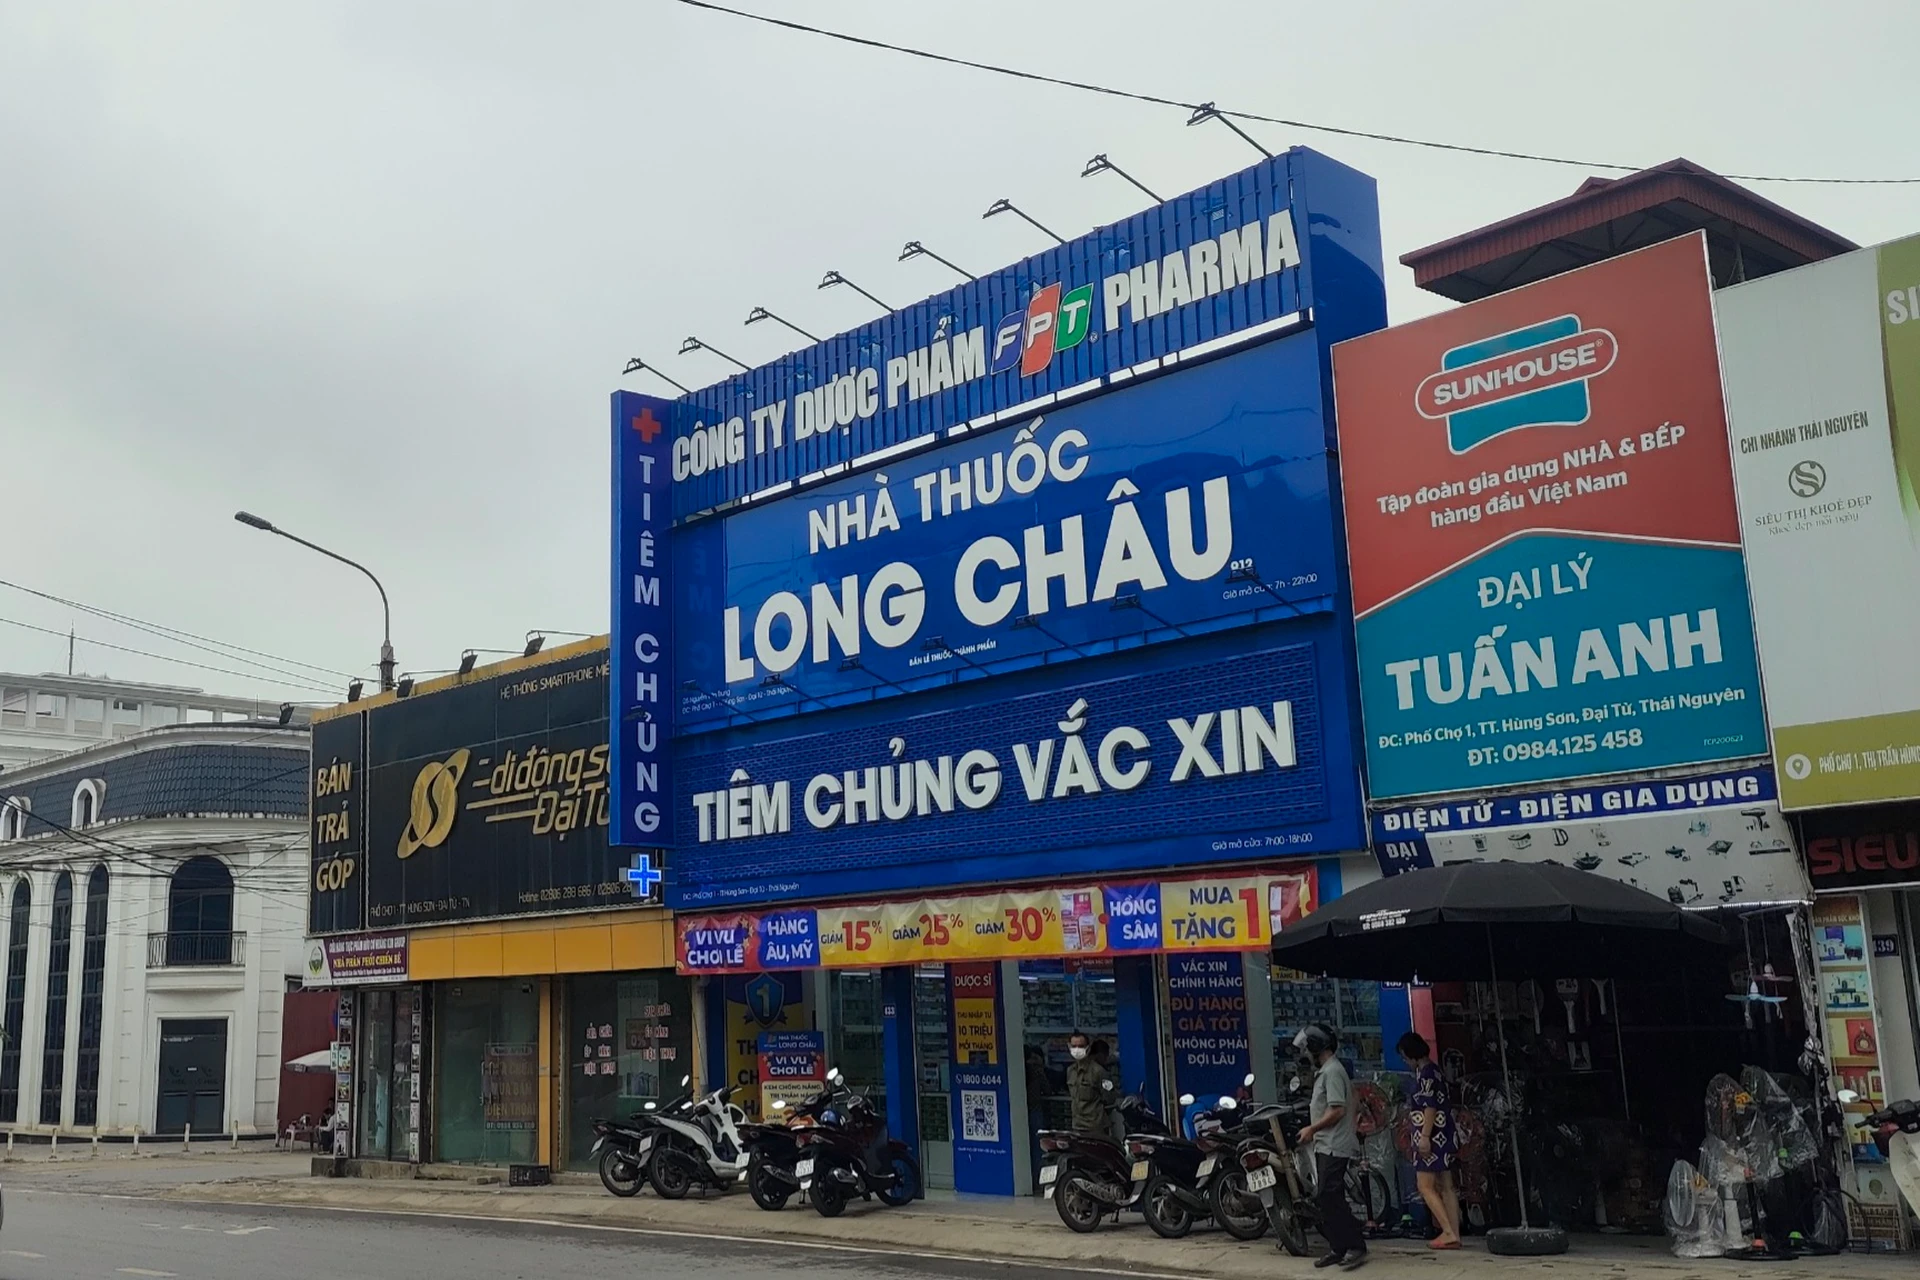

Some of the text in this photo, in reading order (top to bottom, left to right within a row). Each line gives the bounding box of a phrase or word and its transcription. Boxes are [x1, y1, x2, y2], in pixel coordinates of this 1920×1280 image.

[672, 208, 1301, 482] CÔNG TY DƯỢC PHẨM FPT PHARMA
[1434, 342, 1596, 406] SUNHOUSE
[1740, 410, 1868, 454] CHI NHÁNH THÁI NGUYÊN
[1378, 422, 1686, 515] Tập đoàn gia dụng NHÀ & BẾP
[809, 415, 1090, 554] NHÀ THUỐC
[1431, 471, 1628, 527] hàng đầu Việt Nam
[1755, 513, 1782, 526] SIÊU
[1785, 508, 1808, 521] THỊ
[724, 477, 1233, 683] LONG CHÂU
[1292, 573, 1317, 586] 22h00
[1478, 552, 1594, 610] ĐẠI LÝ
[634, 455, 660, 834] TIÊM CHỦNG
[1386, 608, 1723, 711] TUẤN ANH
[540, 668, 593, 690] SMARTPHONE
[1378, 686, 1745, 748] ĐC: Phố Chợ 1, TT. Hùng Sơn, Đại Từ, Thái Nguyên
[1468, 728, 1642, 766] ĐT: 0984.125 458
[1819, 752, 1834, 773] PHỐ
[1836, 754, 1851, 774] CHỢ
[1856, 753, 1862, 771] 1,
[1862, 752, 1876, 771] THỊ
[1878, 744, 1899, 767] TRẤN
[316, 757, 351, 797] BÁN
[693, 697, 1298, 842] TIÊM CHỦNG VẮC XIN
[1384, 776, 1759, 831] ĐIỆN TỬ ĐIỆN GIA DỤNG
[316, 800, 349, 844] TRẢ
[1212, 841, 1227, 850] Giờ
[1229, 839, 1242, 849] mở
[1385, 841, 1418, 860] ĐẠI
[316, 852, 354, 892] GÓP
[1110, 896, 1156, 916] HỒNG
[1190, 887, 1260, 938] MUA 1
[696, 929, 734, 945] VI VU
[768, 916, 808, 936] HÀNG
[842, 920, 882, 952] 15%
[919, 914, 964, 946] 25%
[1005, 906, 1056, 942] 30%
[1123, 919, 1158, 940] SÂM
[1172, 913, 1234, 946] TẶNG
[688, 944, 744, 966] CHƠI LỄ
[766, 941, 813, 962] ÂU, MỸ
[1181, 958, 1228, 972] VẮC XIN
[955, 973, 992, 990] DƯỢC SĨ
[1170, 975, 1206, 988] CHÍNH
[1171, 993, 1244, 1010] ĐỦ HÀNG
[959, 1023, 992, 1040] 10 TRIỆU
[1179, 1014, 1240, 1030] GIÁ TỐT
[1174, 1035, 1248, 1048] KHÔNG PHẢI
[770, 1064, 814, 1075] CHƠI LỄ
[776, 1056, 807, 1064] VI VU
[1188, 1052, 1236, 1067] ĐỢI LÂU
[982, 1075, 1002, 1085] 6044
